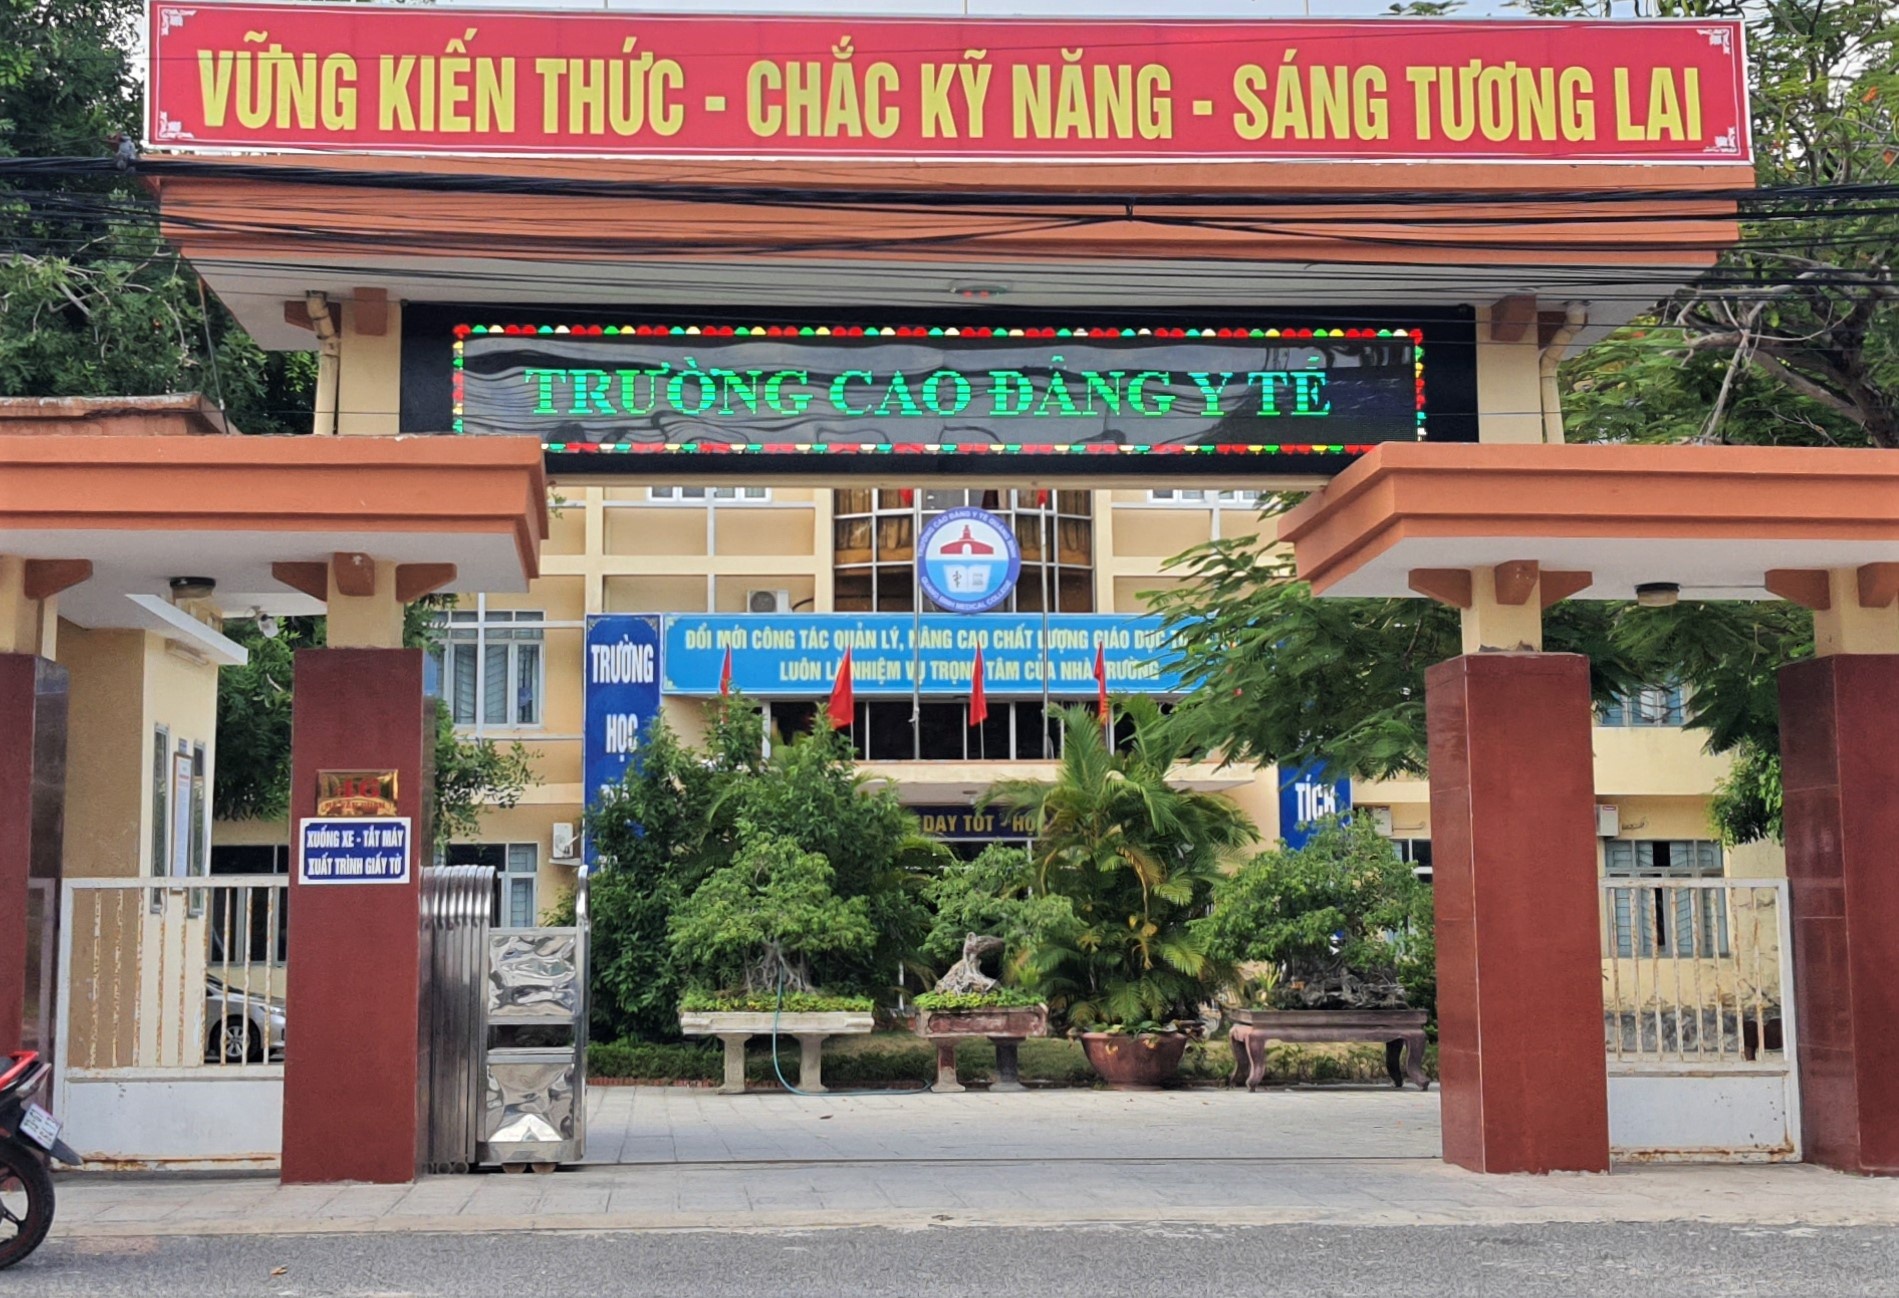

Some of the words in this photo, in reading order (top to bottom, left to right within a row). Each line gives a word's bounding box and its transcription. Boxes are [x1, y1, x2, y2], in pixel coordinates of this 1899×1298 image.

[197, 30, 357, 131] VỮNG
[378, 28, 515, 133] KIẾN
[535, 36, 684, 136] THỨC
[705, 96, 726, 112] -
[746, 35, 900, 138] CHẮC
[921, 48, 993, 139] KỸ
[1012, 48, 1172, 140] NĂNG
[1192, 100, 1213, 116] -
[1232, 48, 1389, 141] SÁNG
[1406, 58, 1596, 142] TƯƠNG
[1613, 66, 1702, 142] LAI
[524, 356, 815, 415] TRƯỜNG
[828, 370, 971, 416] CAO
[1187, 370, 1234, 416] Y
[716, 624, 747, 650] MỚI
[752, 625, 796, 650] CÔNG
[799, 625, 830, 650] TÁC
[833, 621, 877, 651] QUẢN
[957, 629, 989, 649] CAO
[993, 622, 1034, 650] CHẤT
[1093, 625, 1130, 650] GIÁO
[590, 633, 654, 683] TRƯỜNG
[780, 656, 821, 681] LUÔN
[852, 656, 901, 685] NHIỆM
[930, 660, 973, 685] TRỌN
[986, 657, 1020, 680] TÂM
[1060, 657, 1093, 680] NHÀ
[1106, 655, 1159, 680] RƯỜNG
[606, 713, 638, 763] HỌC
[306, 824, 340, 848] XUỐNG
[341, 830, 355, 848] XE
[381, 826, 404, 848] MÁY
[307, 851, 333, 875] XUẤT
[334, 853, 364, 875] TRÌNH
